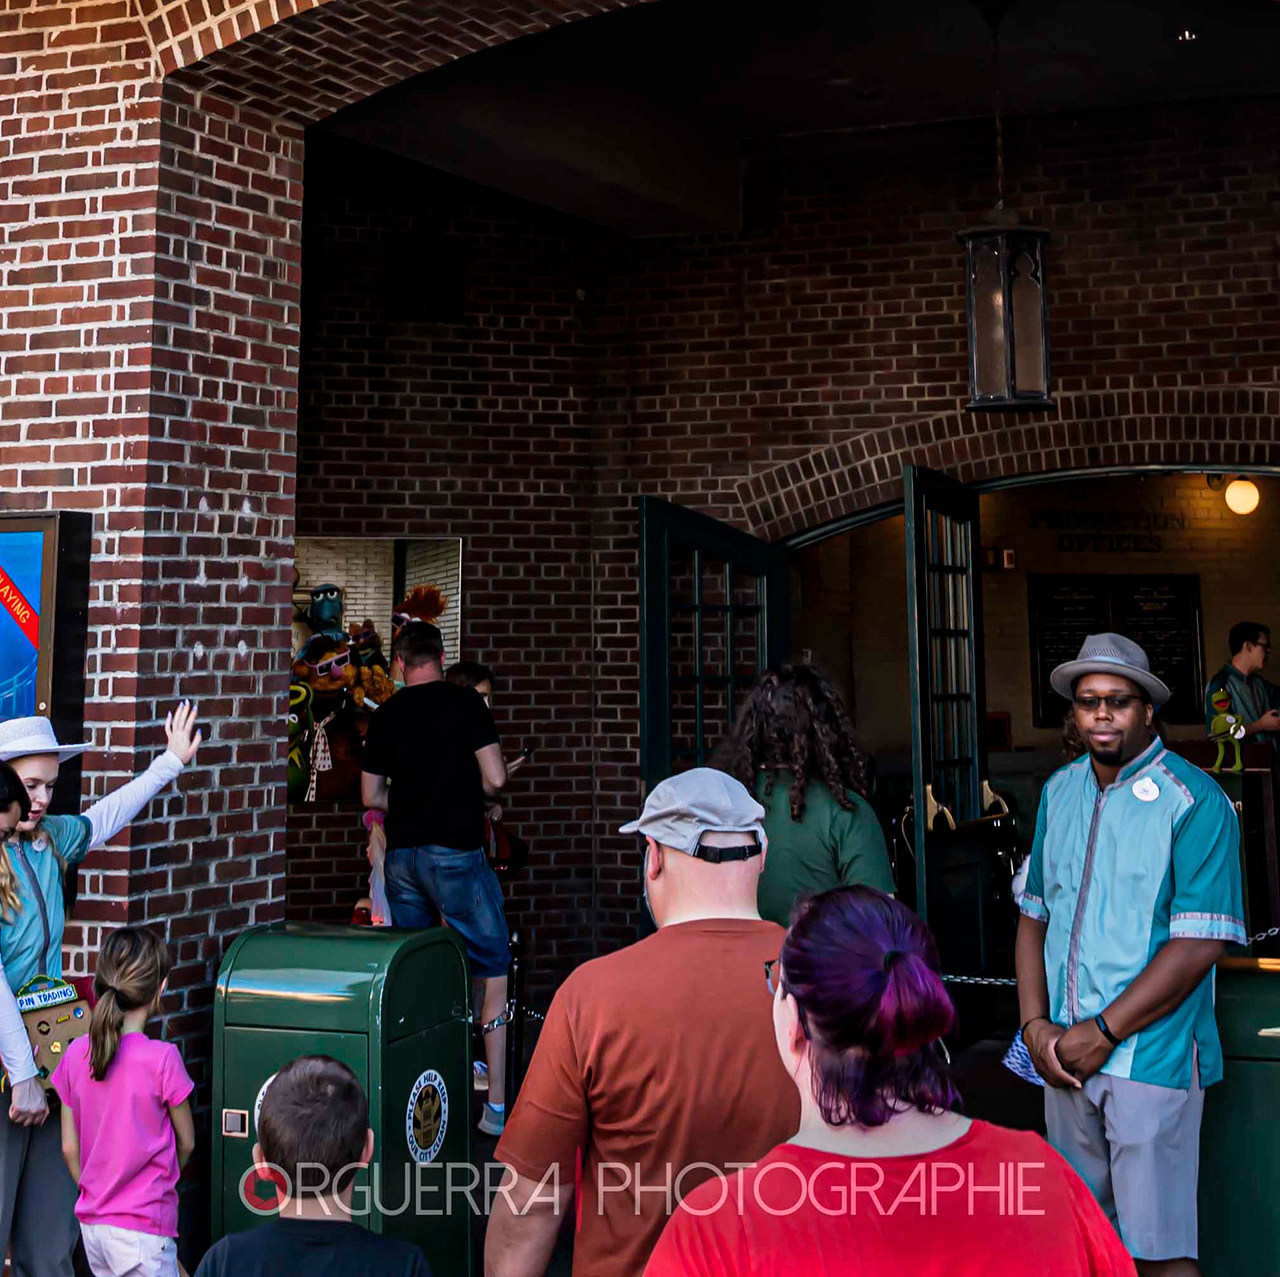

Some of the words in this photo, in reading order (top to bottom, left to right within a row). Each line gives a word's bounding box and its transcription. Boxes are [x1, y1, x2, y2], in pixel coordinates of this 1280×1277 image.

[19, 998, 35, 1008] PIN
[37, 988, 73, 1004] TRADING
[408, 1134, 419, 1157] OUR
